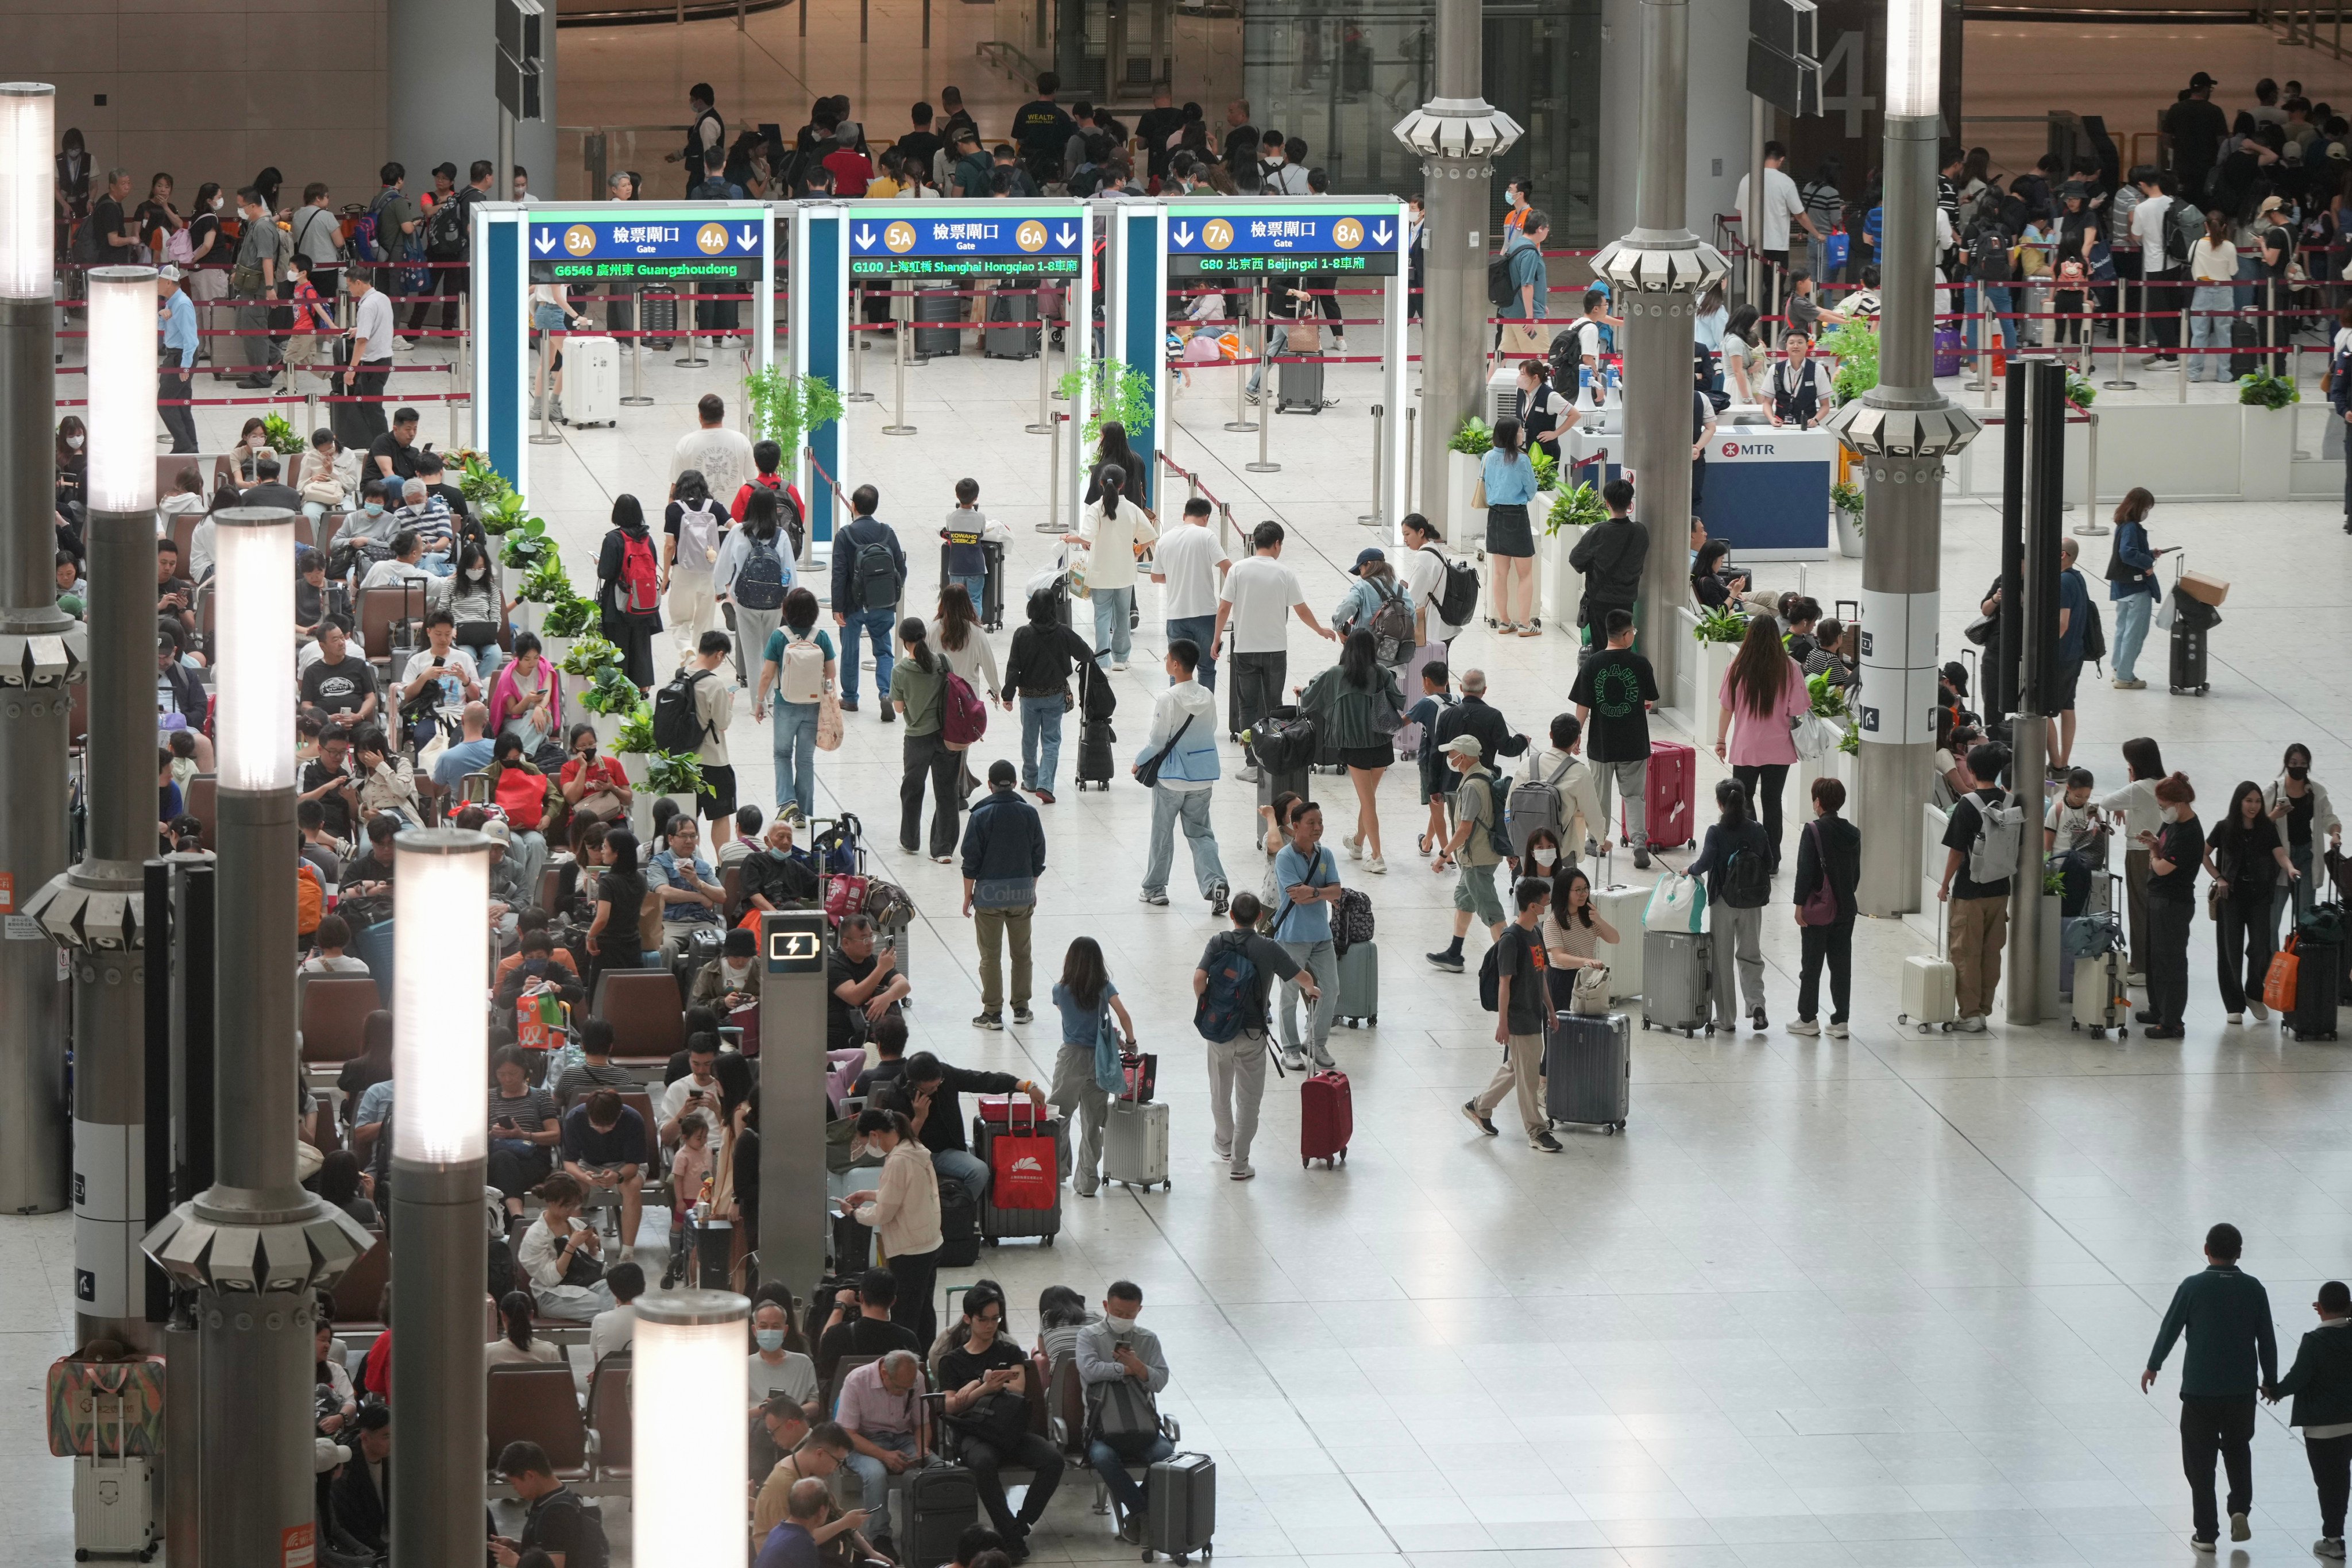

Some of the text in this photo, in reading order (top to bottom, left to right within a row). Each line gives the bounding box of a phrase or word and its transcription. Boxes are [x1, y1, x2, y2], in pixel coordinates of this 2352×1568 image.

[613, 226, 679, 244] 檢票閘口
[889, 229, 912, 246] 5A
[933, 223, 999, 240] 檢票閘口
[1020, 227, 1044, 245] 6A
[1208, 226, 1230, 243] 7A
[1250, 221, 1316, 238] 檢票閘口
[1336, 225, 1360, 242] 8A
[569, 231, 592, 249] 3A
[700, 230, 724, 248] 4A
[956, 242, 975, 250] Gate
[1273, 239, 1293, 248] Gate
[636, 245, 656, 253] Gate
[555, 263, 737, 277] G6546 廣州東 Guangzhoudong
[853, 260, 1078, 275] G100 上海虹橋 Shanghai Hongqiao 1-8車廂
[1200, 257, 1365, 272] G80 北京西 Beijingxi 1-8車廂
[1741, 445, 1774, 455] MTR
